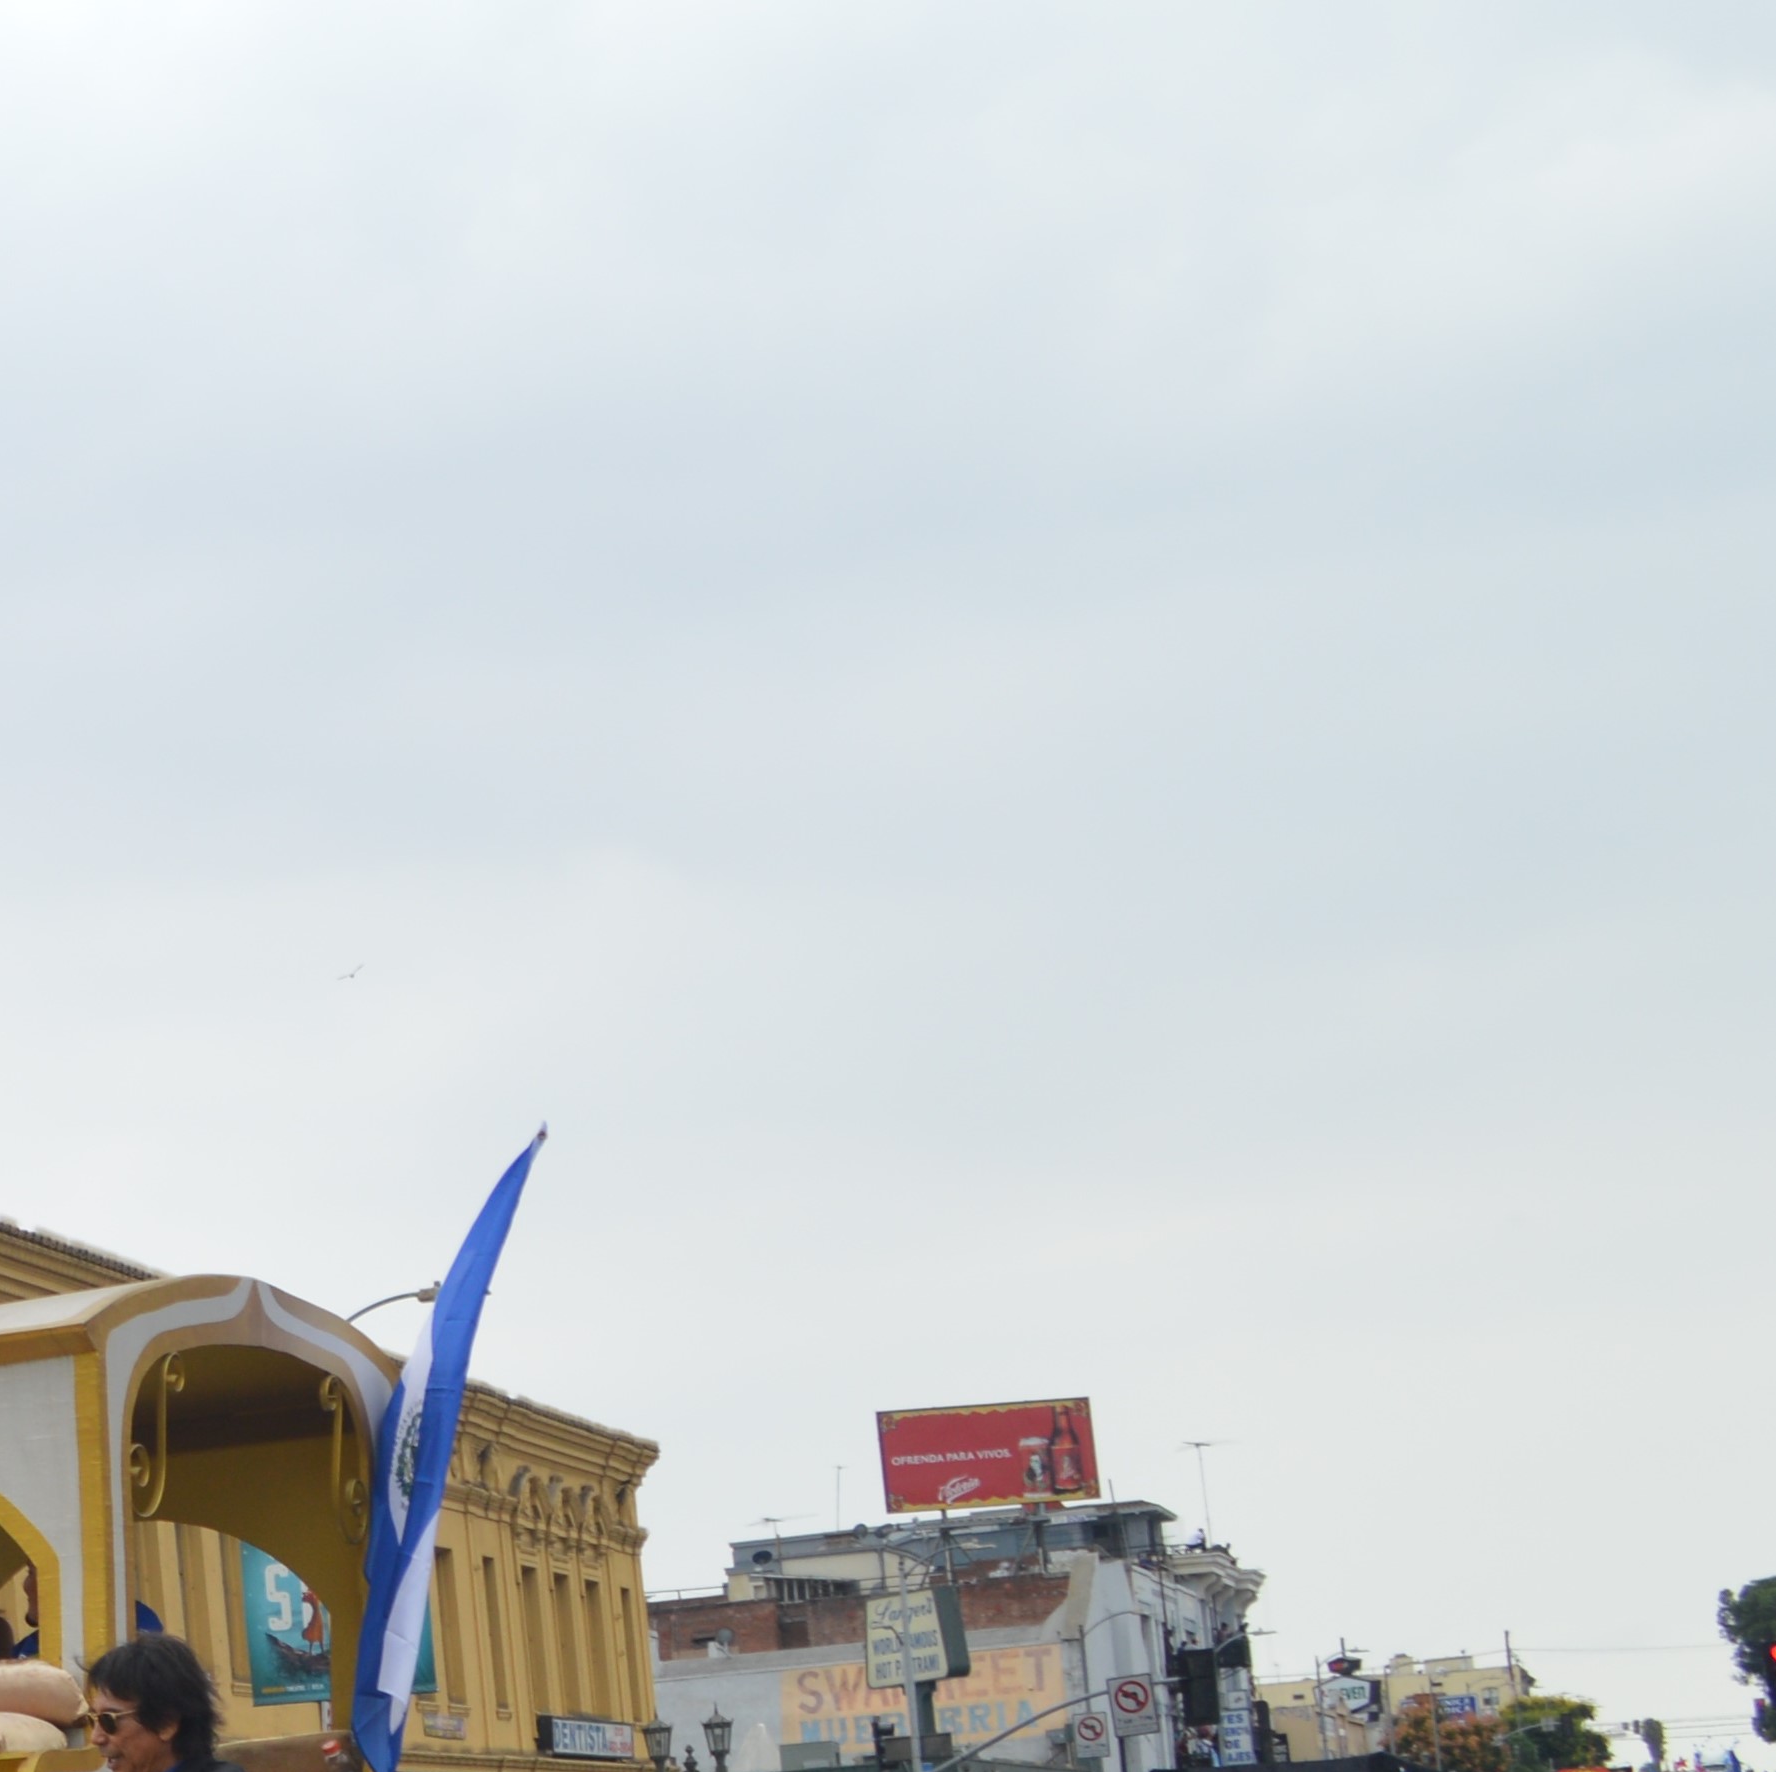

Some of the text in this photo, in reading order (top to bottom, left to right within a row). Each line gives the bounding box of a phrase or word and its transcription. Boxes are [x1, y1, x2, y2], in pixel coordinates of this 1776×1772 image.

[891, 1454, 945, 1467] OFRENDA
[946, 1451, 975, 1462] PARA
[875, 1662, 893, 1681] HOT
[553, 1721, 608, 1751] DENTISTA
